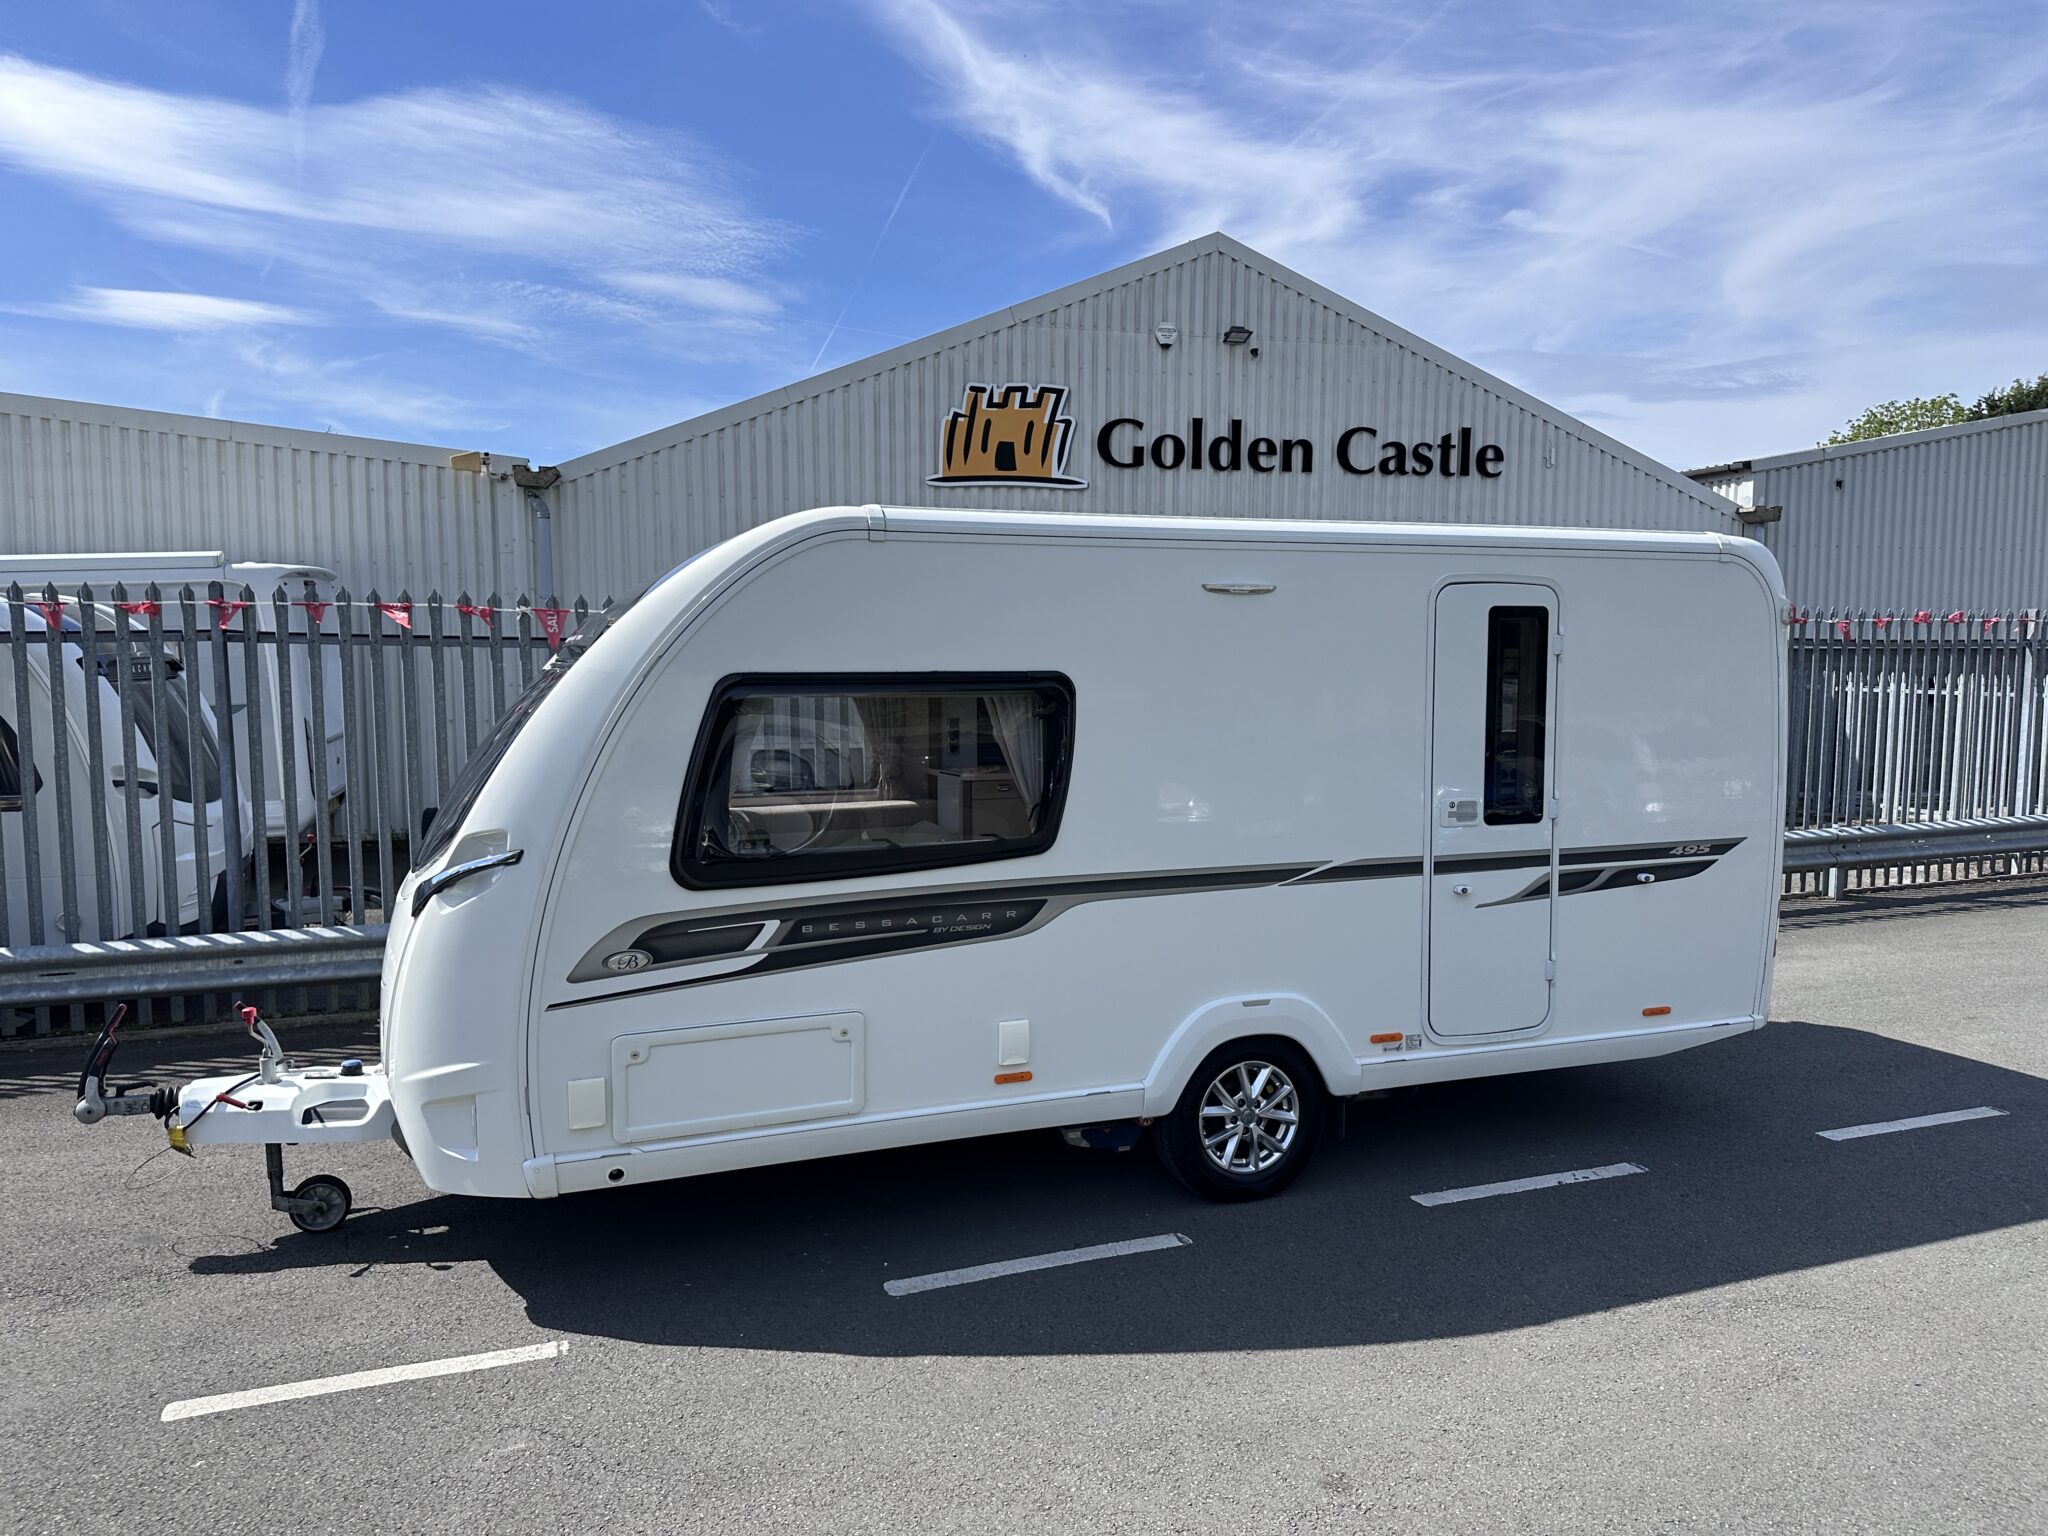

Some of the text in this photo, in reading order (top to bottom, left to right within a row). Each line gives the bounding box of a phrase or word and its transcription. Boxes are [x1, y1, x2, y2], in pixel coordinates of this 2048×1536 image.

[1097, 417, 1505, 478] Golden Castle
[1669, 844, 1712, 855] 495
[802, 910, 1017, 933] BESSACARR
[932, 923, 992, 934] BY DESIGN
